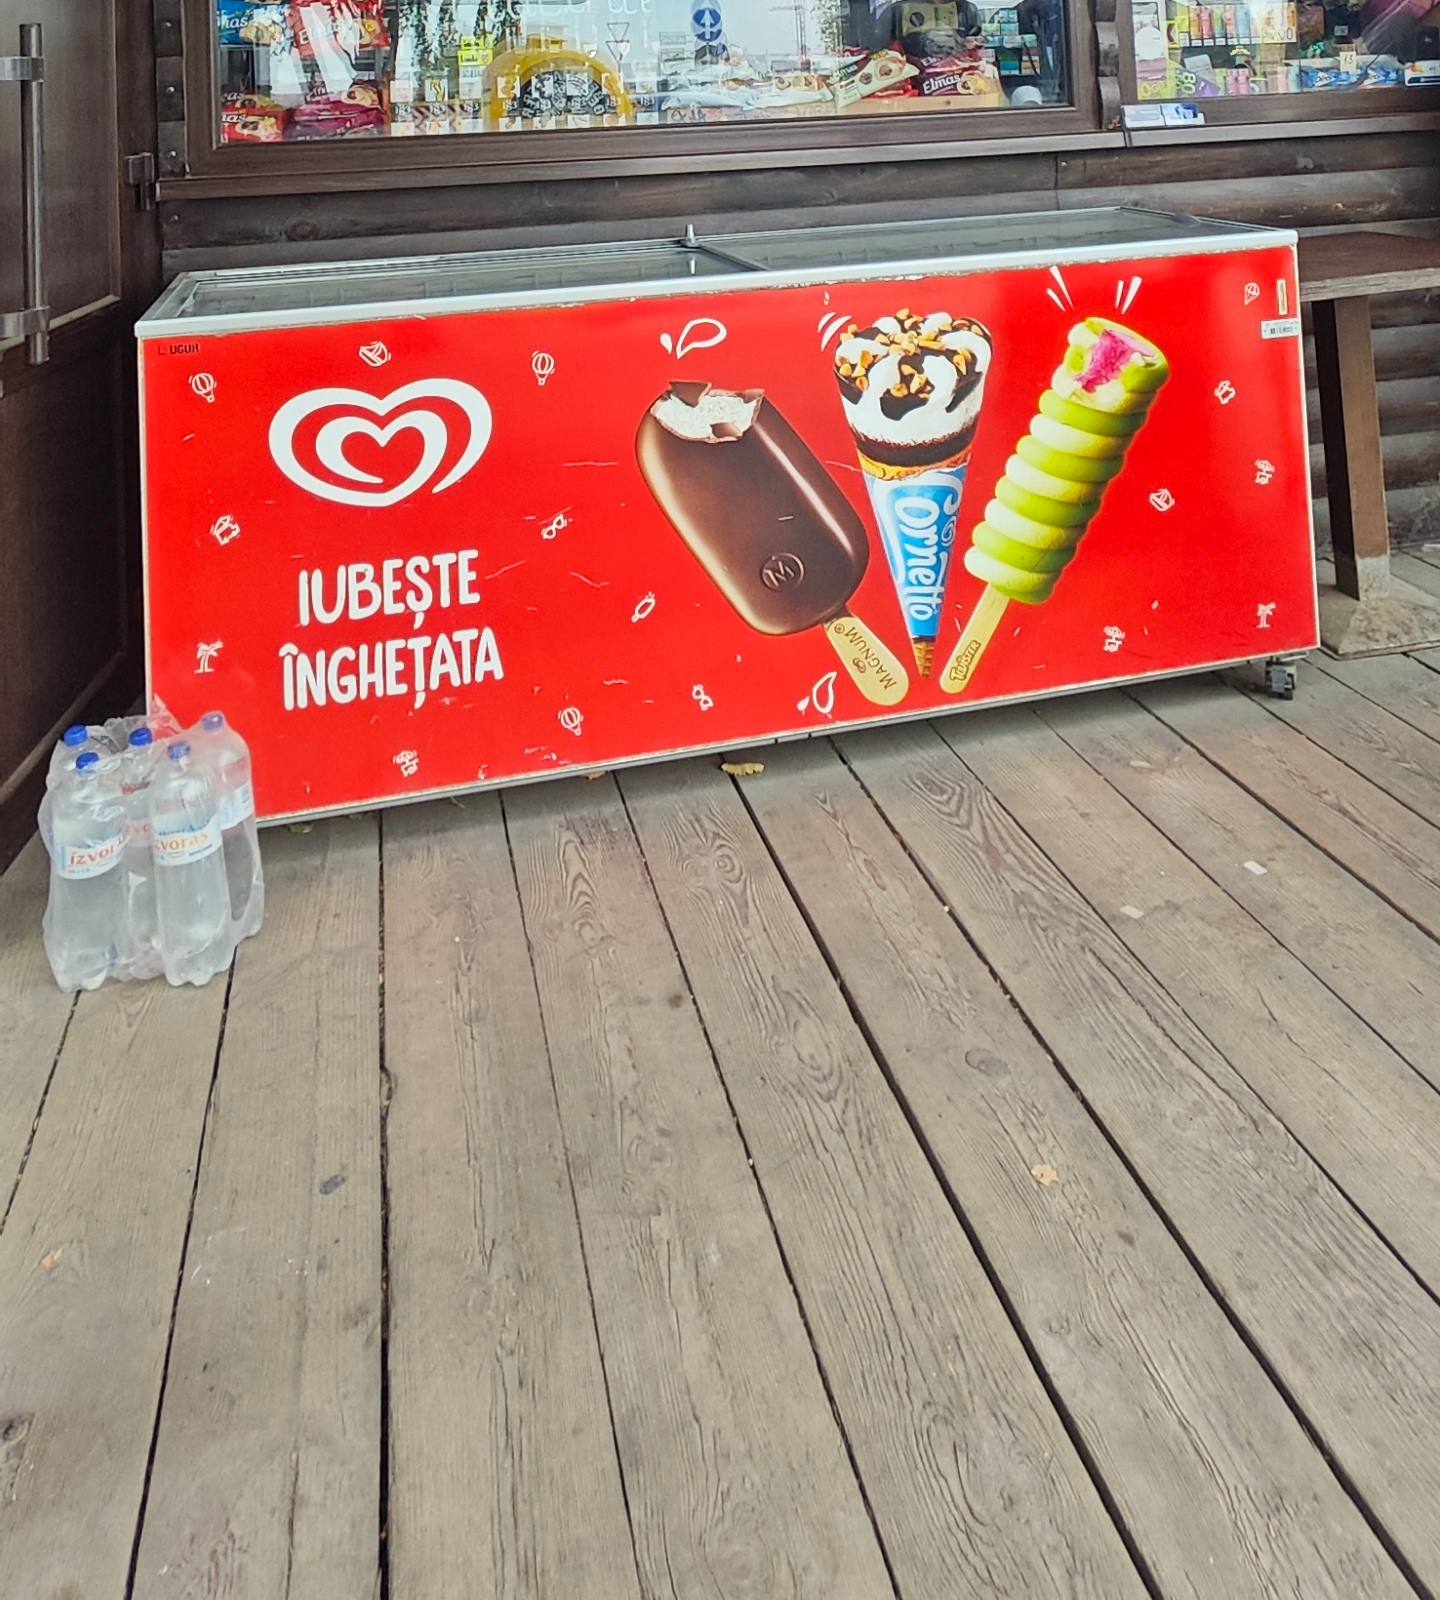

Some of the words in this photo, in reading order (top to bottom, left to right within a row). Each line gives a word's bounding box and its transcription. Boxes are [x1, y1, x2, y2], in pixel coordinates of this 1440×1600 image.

[922, 74, 961, 95] Elmas
[886, 472, 964, 622] Cornetto
[278, 626, 504, 711] ÎNGHEȚATA
